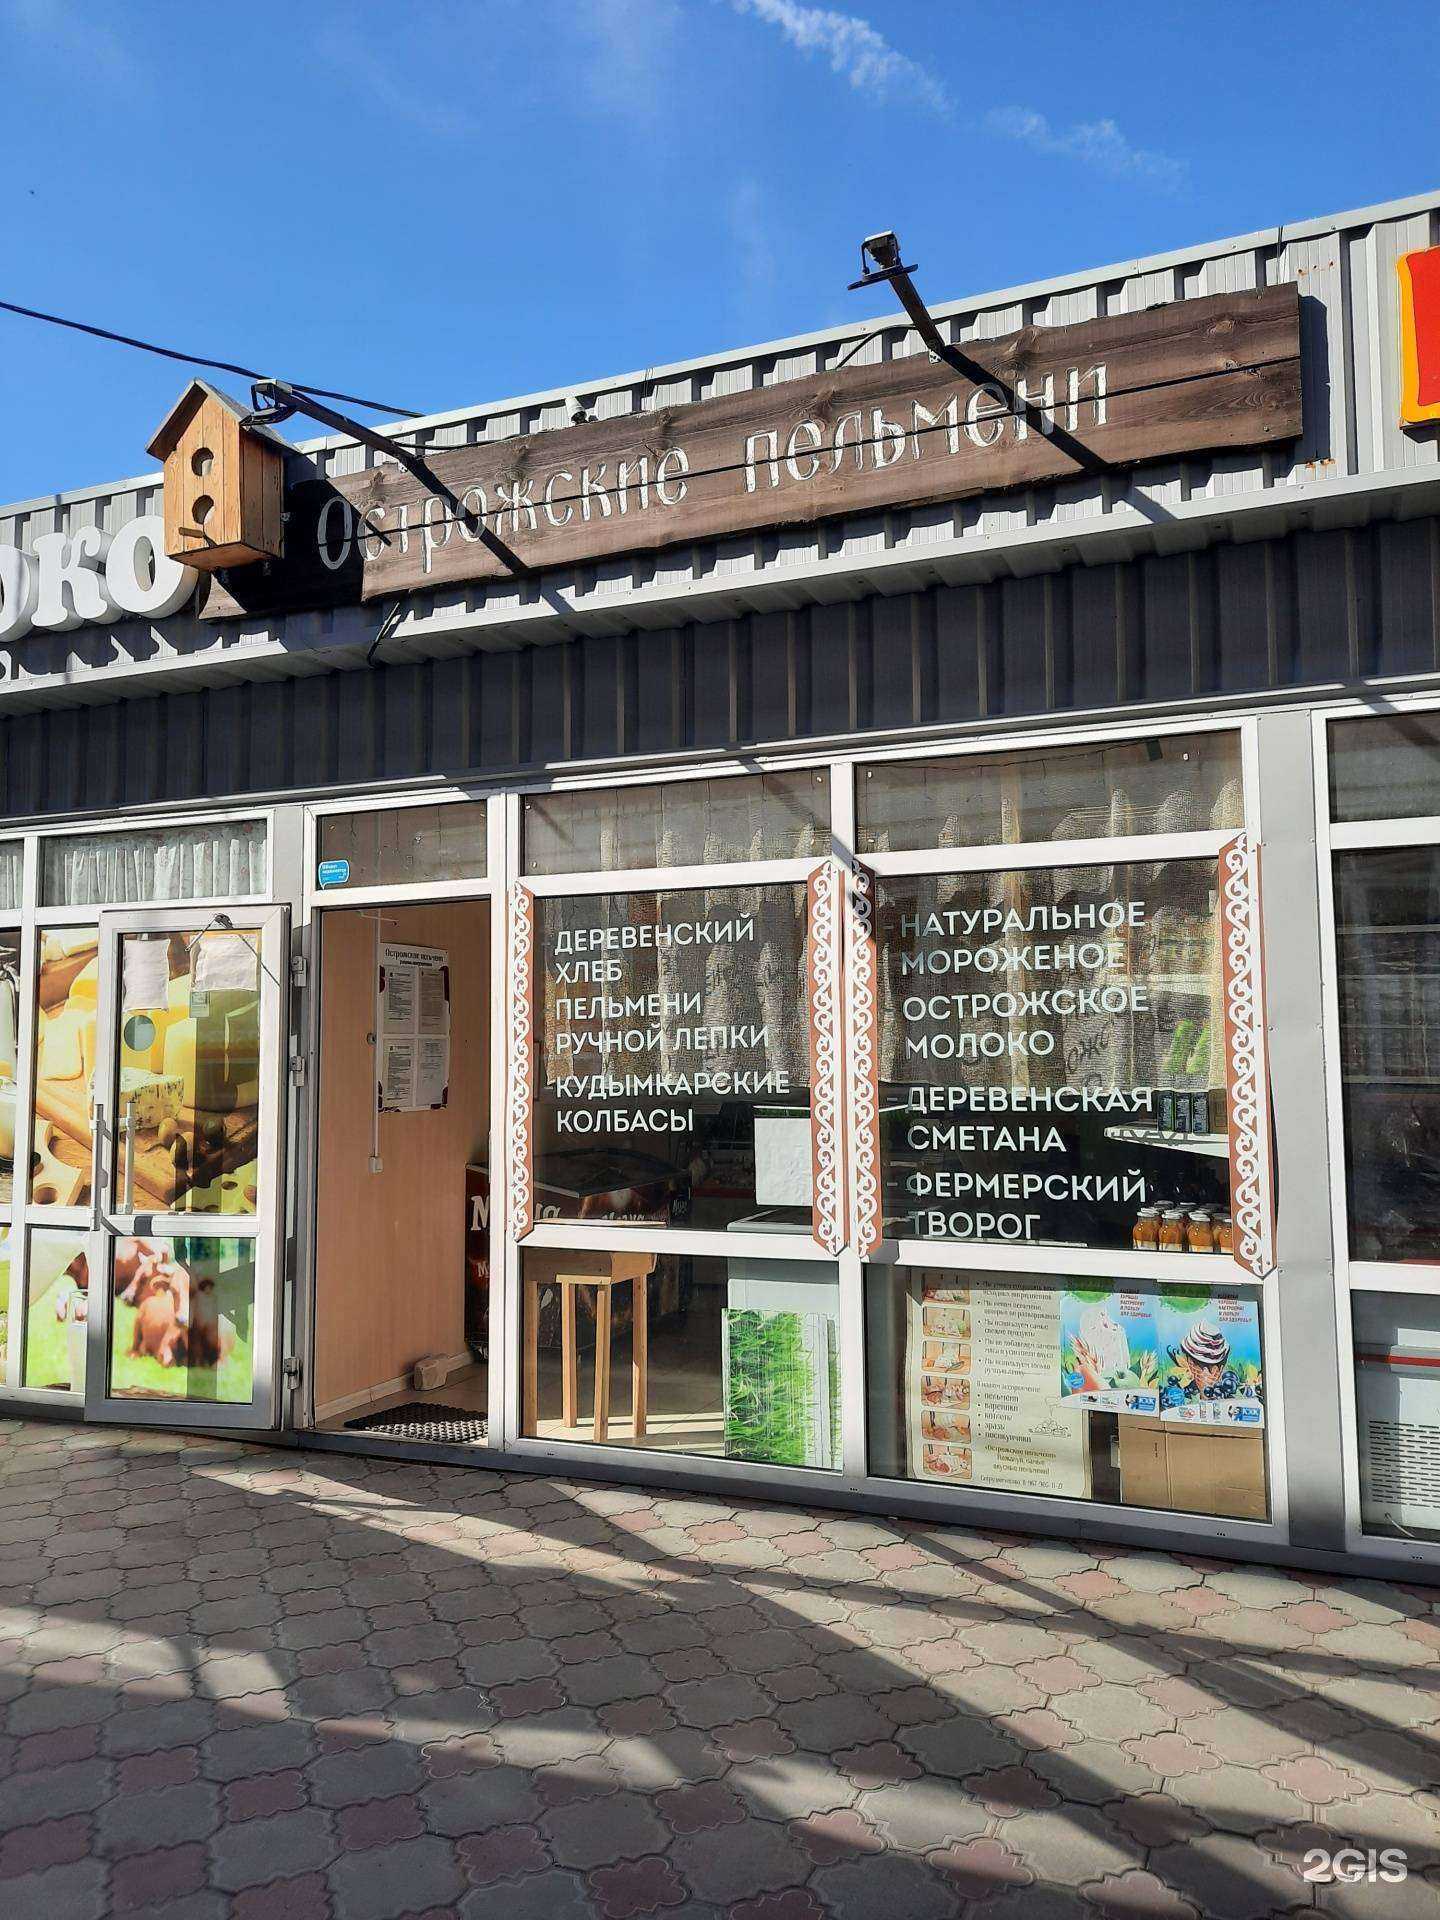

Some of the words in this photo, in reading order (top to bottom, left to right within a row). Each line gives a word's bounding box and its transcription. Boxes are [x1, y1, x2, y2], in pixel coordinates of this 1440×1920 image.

[317, 447, 690, 574] Острожские
[744, 362, 1107, 493] пельмени
[554, 913, 755, 955] ДЕРЕВЕНСКИЙ
[901, 901, 1146, 937] НАТУРАЛЬНОЕ
[555, 959, 623, 984] ХЛЕБ
[901, 942, 1125, 975] МОРОЖЕНОЕ
[555, 993, 702, 1020] ПЕЛЬМЕНИ
[903, 986, 1149, 1022] ОСТРОЖСКОЕ
[556, 1023, 664, 1054] РУЧНОЙ
[673, 1025, 769, 1050] ЛЕПКИ
[905, 1030, 1055, 1060] МОЛОКО
[556, 1071, 790, 1099] КУДЫМКАРСКИЕ
[905, 1086, 1153, 1115] ДЕРЕВЕНСКАЯ
[557, 1108, 694, 1133] КОЛБАСЫ
[907, 1125, 1067, 1152] СМЕТАНА
[906, 1168, 1147, 1203] ФЕРМЕРСКИЙ
[911, 1211, 1041, 1239] ТВОРОГ
